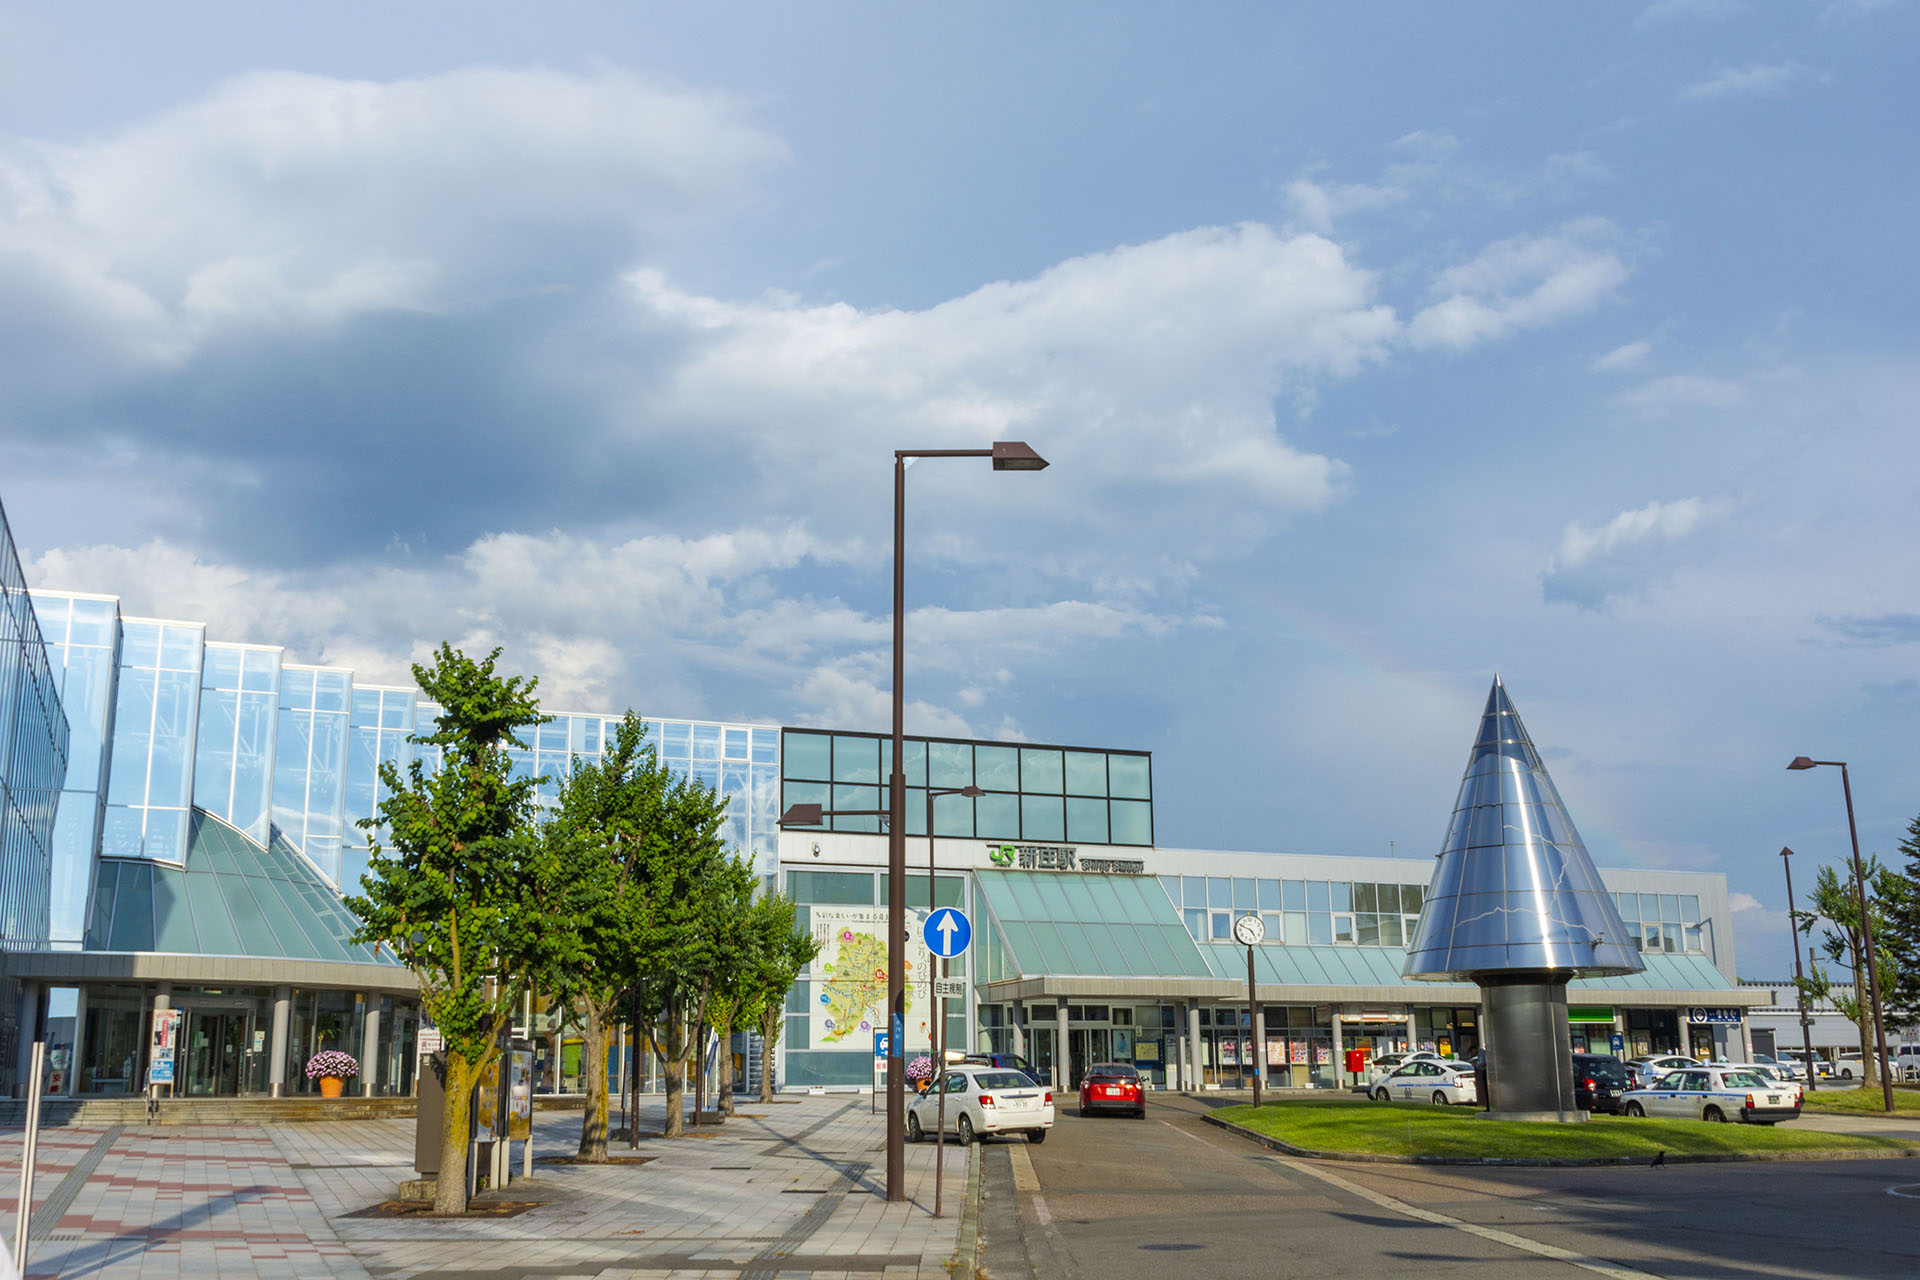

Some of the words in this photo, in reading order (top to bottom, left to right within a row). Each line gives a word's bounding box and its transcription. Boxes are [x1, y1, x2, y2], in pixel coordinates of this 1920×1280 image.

[990, 845, 1016, 862] JR
[1019, 847, 1077, 869] 新庄駅
